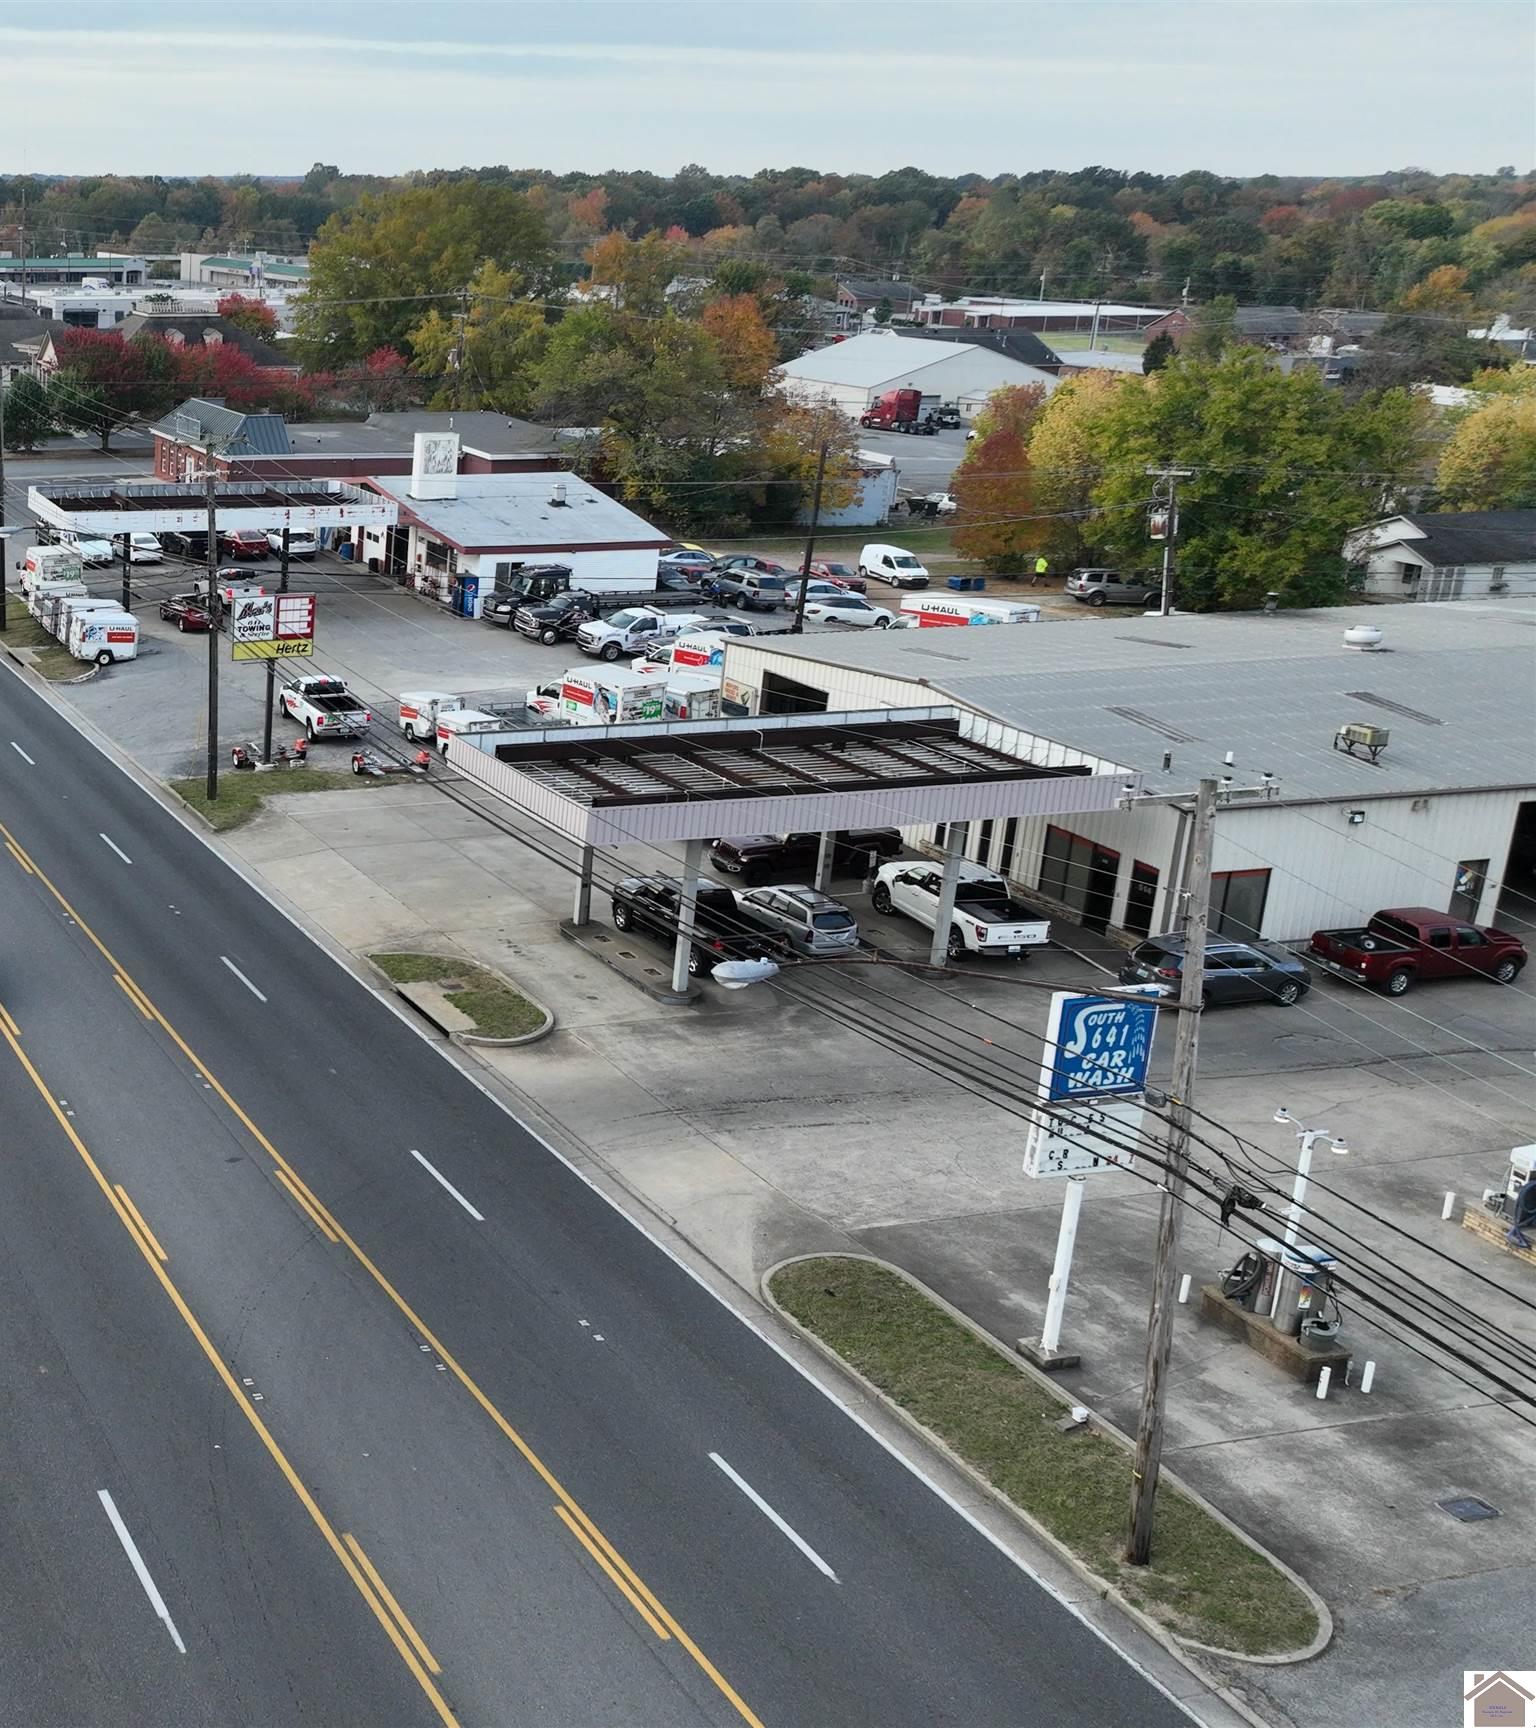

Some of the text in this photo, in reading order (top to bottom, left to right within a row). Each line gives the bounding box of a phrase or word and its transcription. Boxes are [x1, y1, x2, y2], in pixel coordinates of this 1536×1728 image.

[921, 604, 960, 615] U-HAUL
[237, 624, 271, 633] TOWING
[276, 643, 309, 654] Hertz
[679, 642, 708, 652] U-HAUL
[566, 676, 592, 690] U-HAUL
[1064, 1003, 1126, 1058] SOUTH
[1092, 1024, 1129, 1049] 641
[1081, 1050, 1127, 1070] CAR
[1068, 1066, 1134, 1089] WASH
